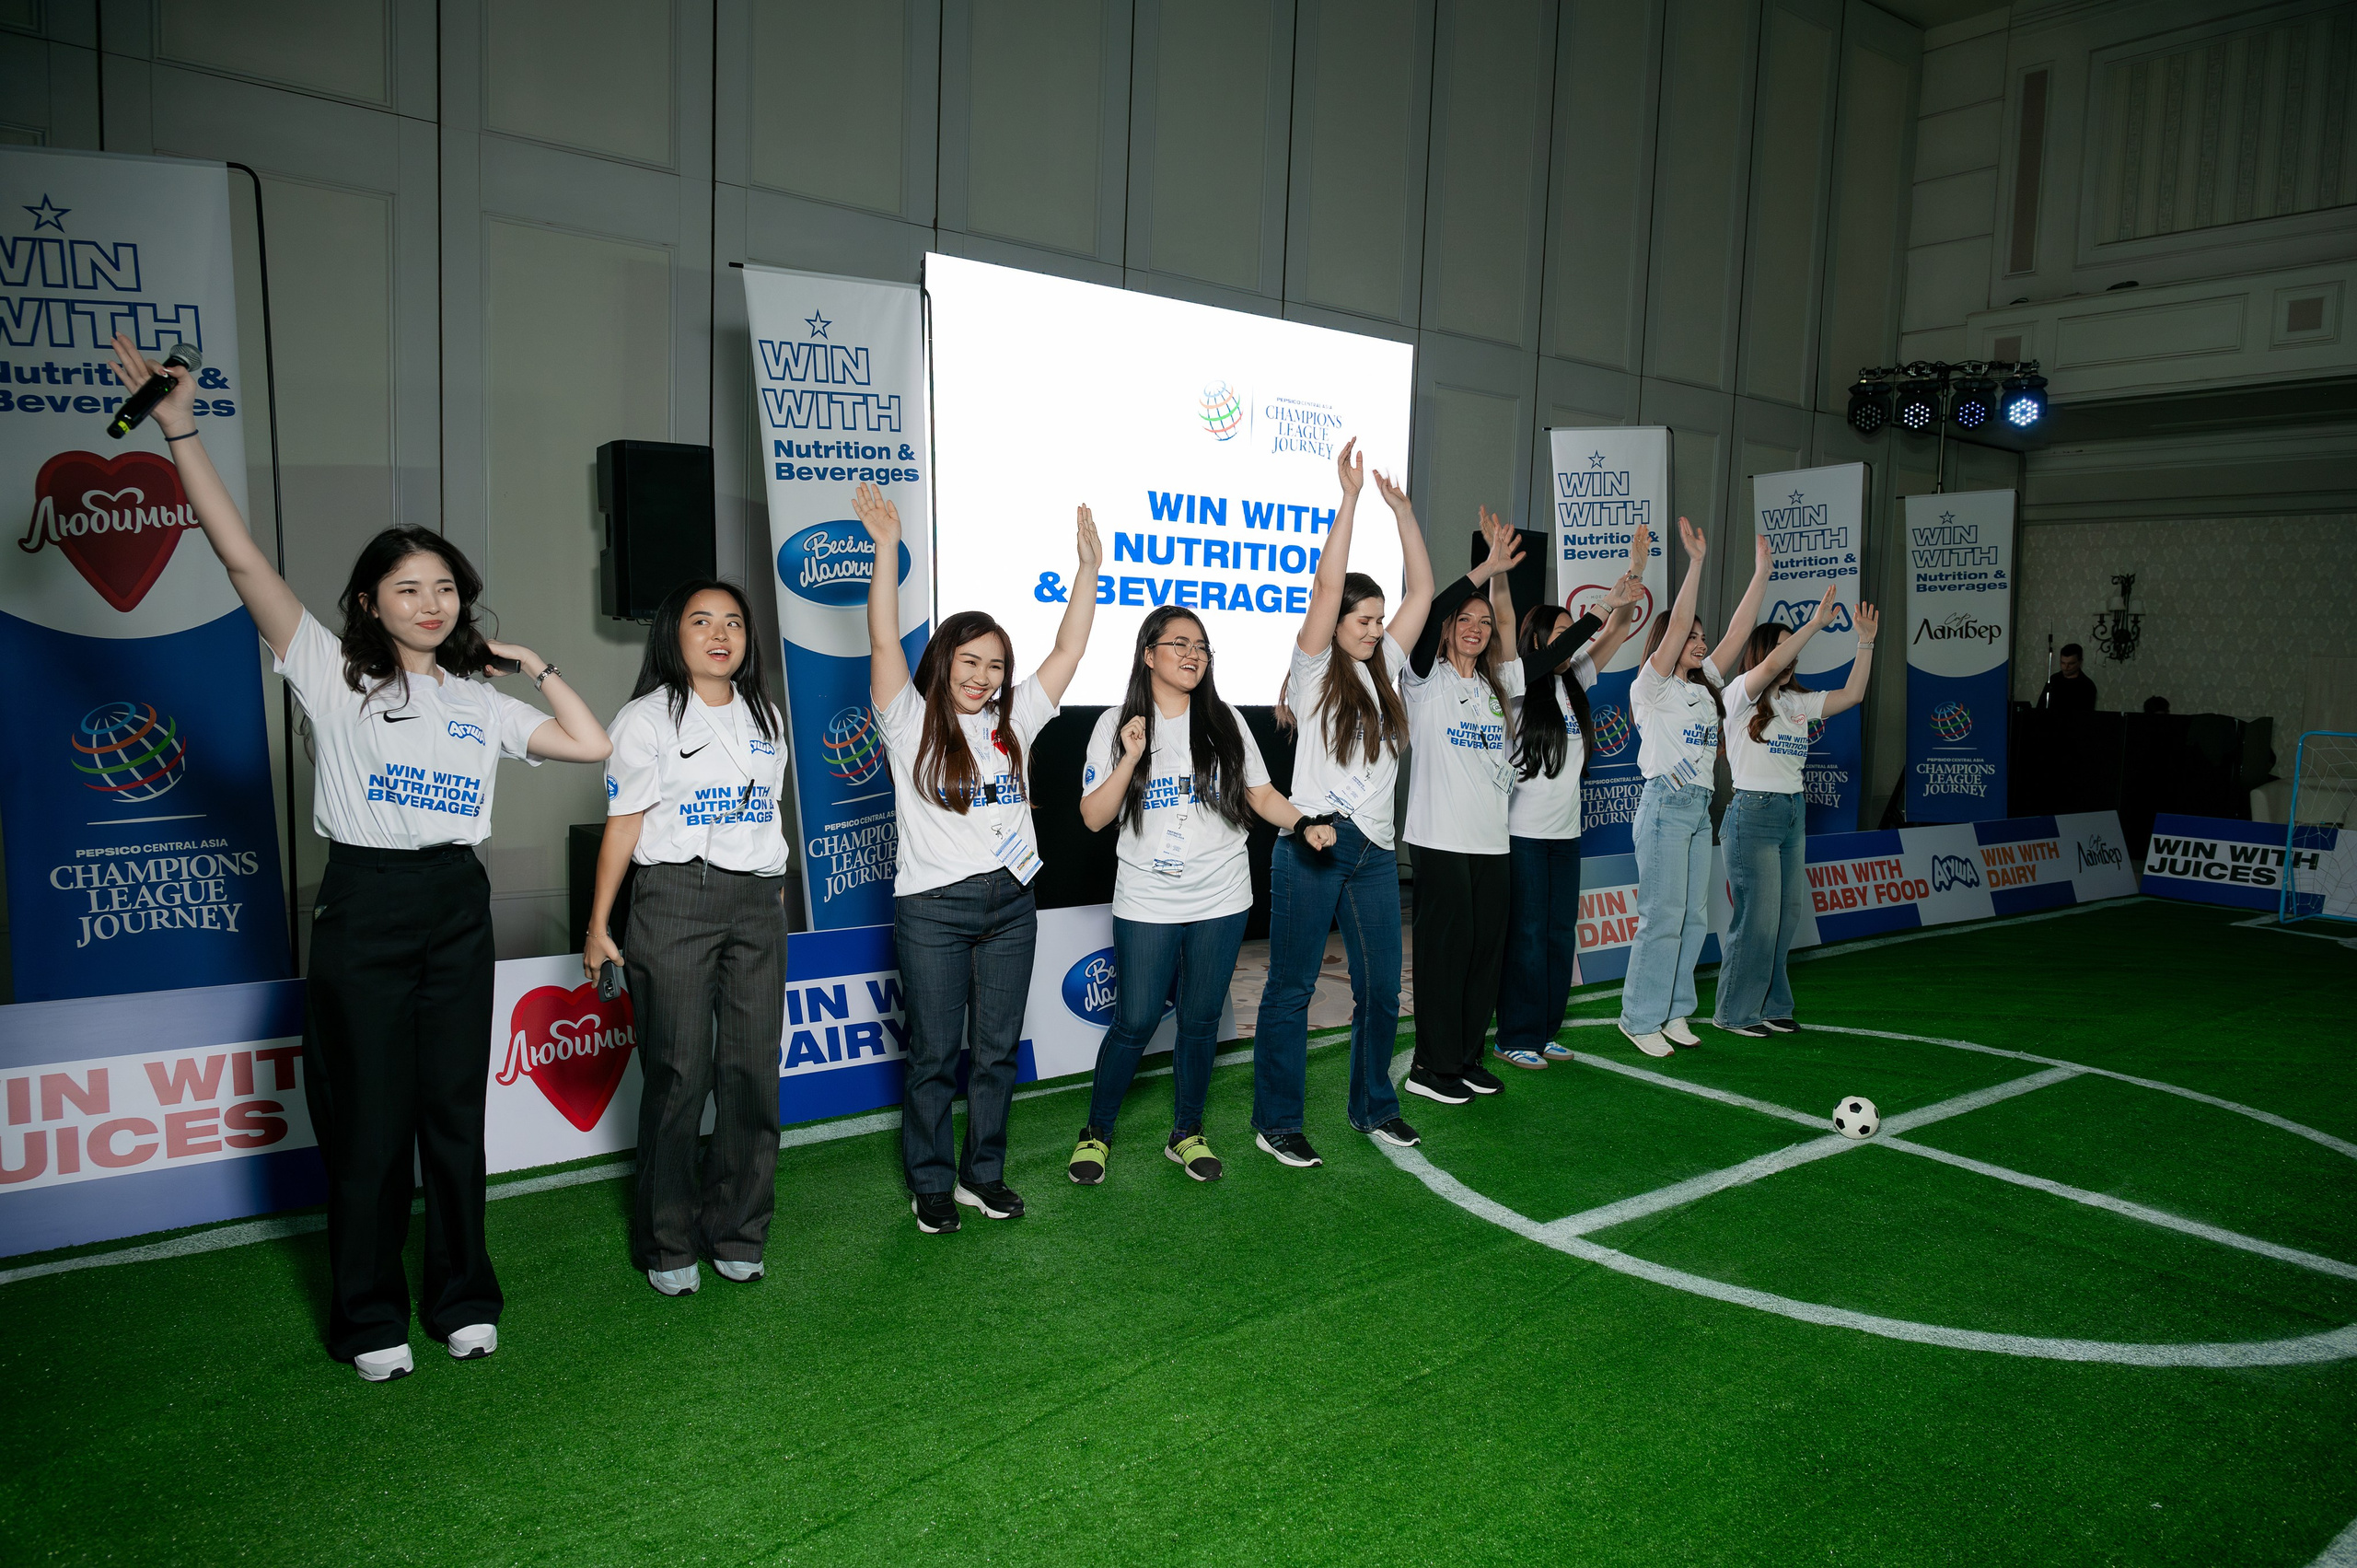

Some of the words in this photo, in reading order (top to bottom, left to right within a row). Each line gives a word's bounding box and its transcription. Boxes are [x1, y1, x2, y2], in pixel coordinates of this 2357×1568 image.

[758, 340, 871, 386] WIN
[197, 367, 230, 389] &
[761, 388, 901, 433] WITH
[1276, 397, 1301, 405] PEPSICO
[1265, 405, 1342, 429] CHAMPIONS
[1279, 422, 1329, 442] LEAGUE
[774, 439, 891, 460] Nutrition
[897, 444, 916, 461] &
[1271, 436, 1333, 460] JOURNEY
[775, 462, 920, 486] Beverages
[1558, 471, 1630, 497] WIN
[1147, 490, 1226, 526] WIN
[1241, 500, 1336, 534] WITH
[1558, 500, 1650, 527] WITH
[1761, 504, 1828, 530] WIN
[803, 531, 876, 560] Весёлы
[1563, 532, 1634, 546] Nutritio
[1647, 531, 1659, 542] &
[1764, 527, 1847, 554] WITH
[1912, 525, 1979, 546] WIN
[1772, 554, 1838, 569] Nutrition
[1843, 552, 1856, 563] &
[1912, 546, 1998, 568] WITH
[799, 556, 874, 588] Молочни
[1768, 565, 1858, 581] Beverages
[1916, 570, 1988, 582] Nutrition
[1994, 570, 2006, 579] &
[1034, 571, 1068, 603] &
[1096, 575, 1313, 614] BEVERAGE
[1916, 580, 2008, 593] Beverages
[1913, 618, 2002, 645] Ламбер
[1778, 734, 1793, 742] WIN
[386, 763, 425, 781] WIN
[433, 772, 481, 791] WITH
[1916, 763, 1995, 774] CHAMPIONS
[1929, 774, 1982, 784] LEAGUE
[368, 774, 478, 804] NUTRITION
[695, 787, 731, 800] WIN
[1805, 783, 1836, 794] AGUE
[1805, 794, 1840, 808] RNEY
[1922, 784, 1988, 797] JOURNEY
[368, 789, 480, 818] BEVERAGES
[687, 811, 773, 826] BEVERAGES
[824, 819, 860, 831] PEPSICO
[860, 813, 886, 823] CENTRAL
[1582, 811, 1637, 831] JOURNE
[75, 845, 141, 858] PEPSICO
[143, 841, 198, 853] CENTRAL
[201, 839, 228, 848] ASIA
[808, 821, 899, 857] CHAMPIO
[830, 841, 898, 875] LEAGUE
[1980, 845, 2015, 867] WIN
[2016, 842, 2061, 864] WITH
[2077, 842, 2122, 873] Ламбер
[2154, 837, 2217, 859] WIN
[2230, 845, 2319, 870] WITH
[50, 851, 259, 890] CHAMPIONS
[824, 860, 898, 903] JOURNE
[1805, 864, 1849, 889] WIN
[1852, 858, 1903, 885] WITH
[1987, 865, 2038, 889] DAIRY
[2147, 857, 2277, 886] JUICES
[87, 878, 227, 913] LEAGUE
[1811, 886, 1869, 912] BABY
[1878, 878, 1930, 904] FOOD
[76, 902, 242, 948] JOURNEY
[785, 984, 849, 1026] IN
[499, 1014, 637, 1083] Любимы
[780, 1018, 911, 1069] AIRY
[0, 1068, 110, 1126] IN
[144, 1046, 303, 1107] WIT
[0, 1099, 288, 1185] UICES
